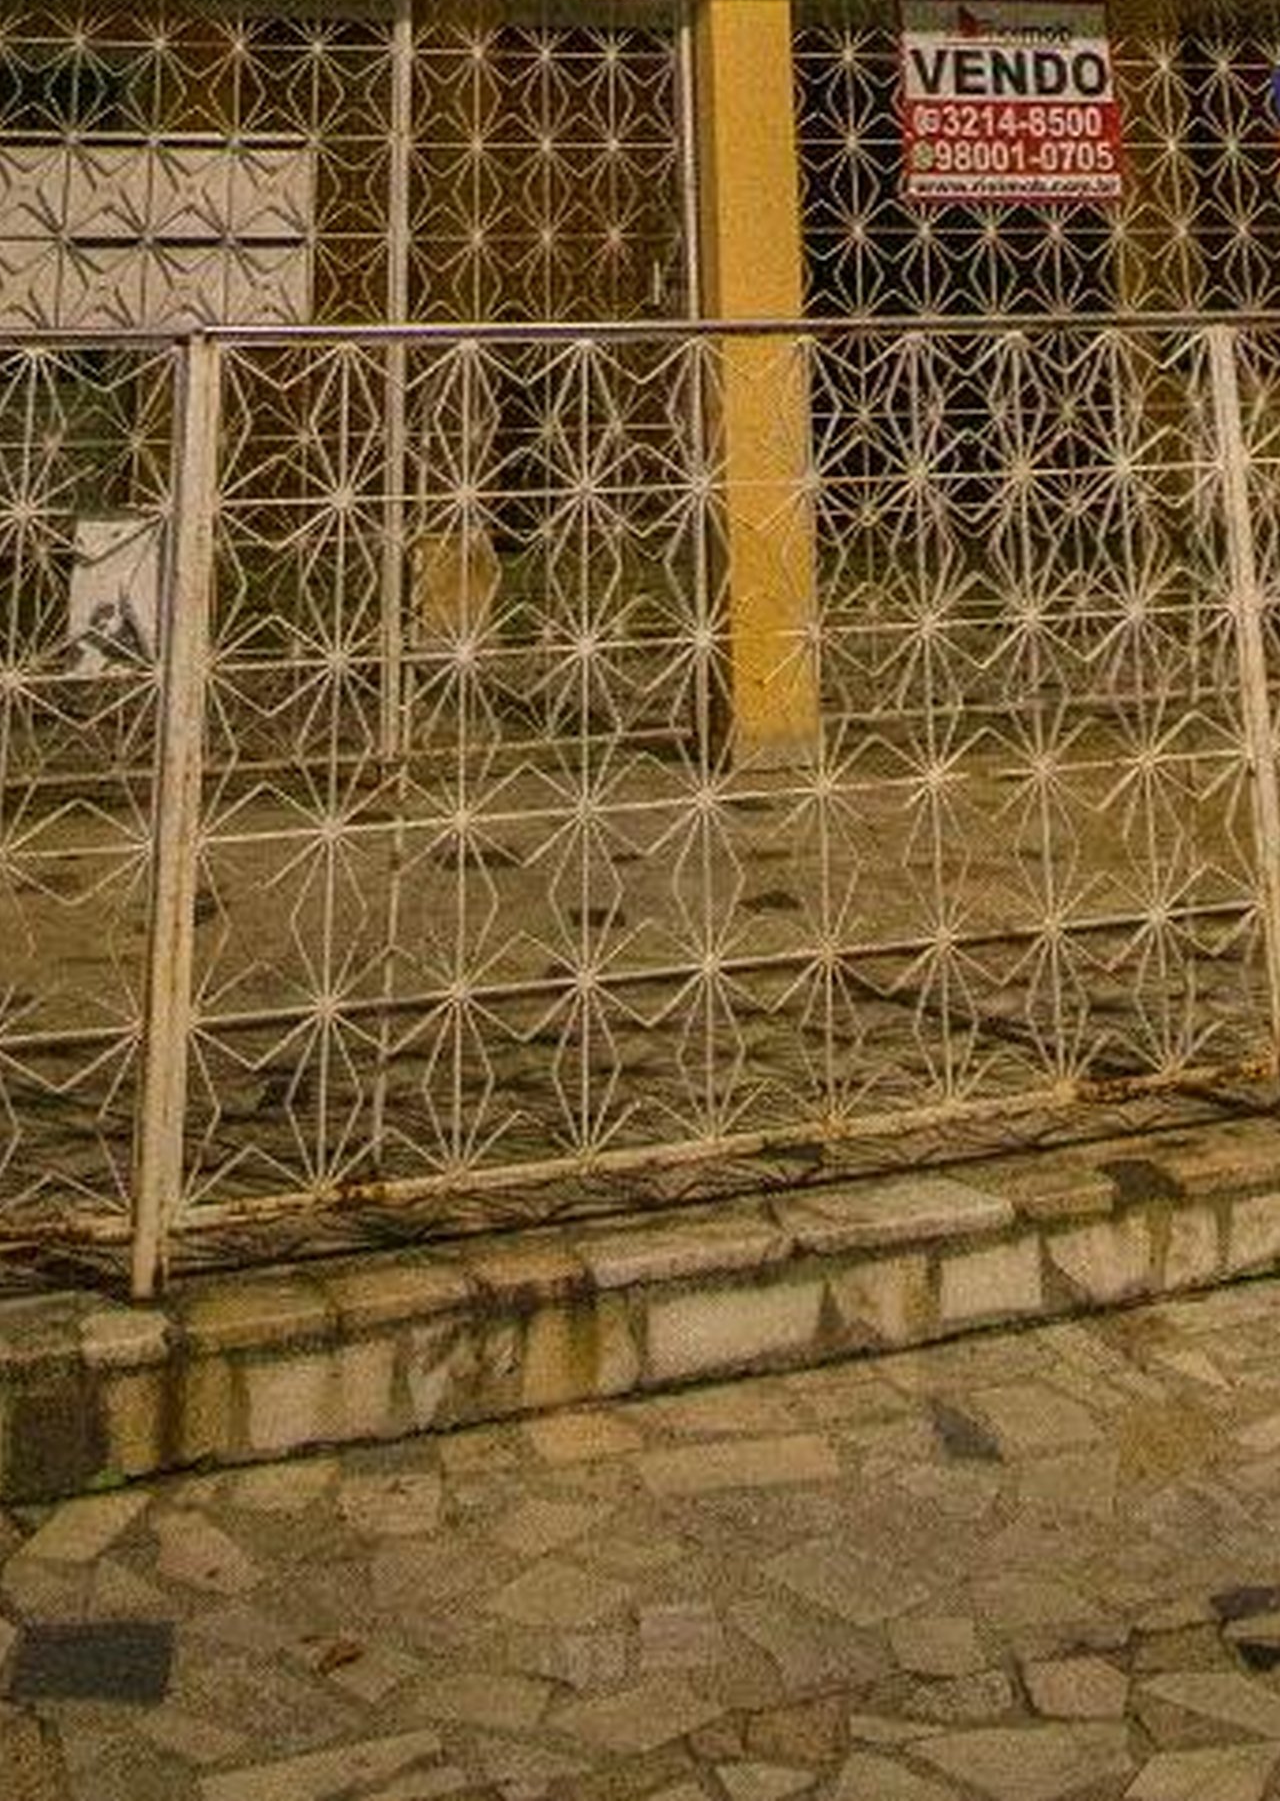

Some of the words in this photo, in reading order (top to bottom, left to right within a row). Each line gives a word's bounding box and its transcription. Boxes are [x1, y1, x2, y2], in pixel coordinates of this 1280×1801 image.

[908, 49, 1108, 96] VENDO
[942, 105, 1102, 138] 3214-8500
[935, 140, 1115, 173] 98001-0705
